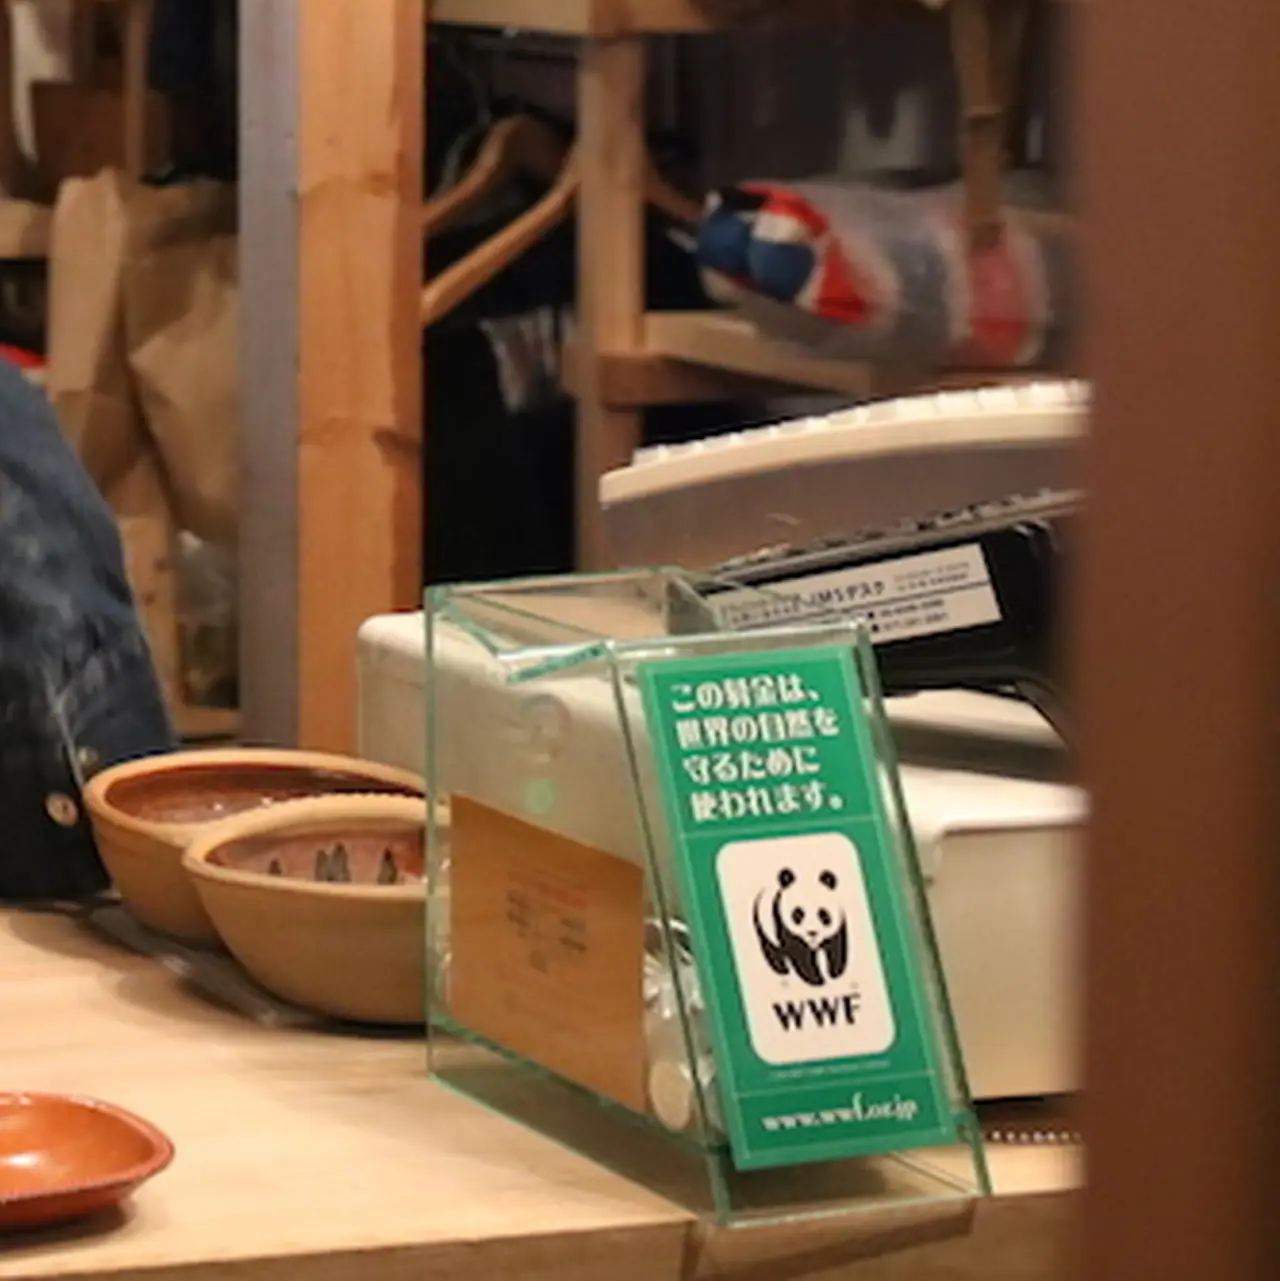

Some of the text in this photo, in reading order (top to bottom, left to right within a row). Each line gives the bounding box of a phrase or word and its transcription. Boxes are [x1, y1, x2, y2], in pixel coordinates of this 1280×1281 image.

[671, 673, 820, 712] この募金は、
[676, 706, 839, 750] 世界の自然を
[682, 746, 821, 785] 守るために
[692, 780, 843, 822] 使われます。
[772, 993, 861, 1032] WWF
[762, 1092, 919, 1131] www.wwf.or.jp
